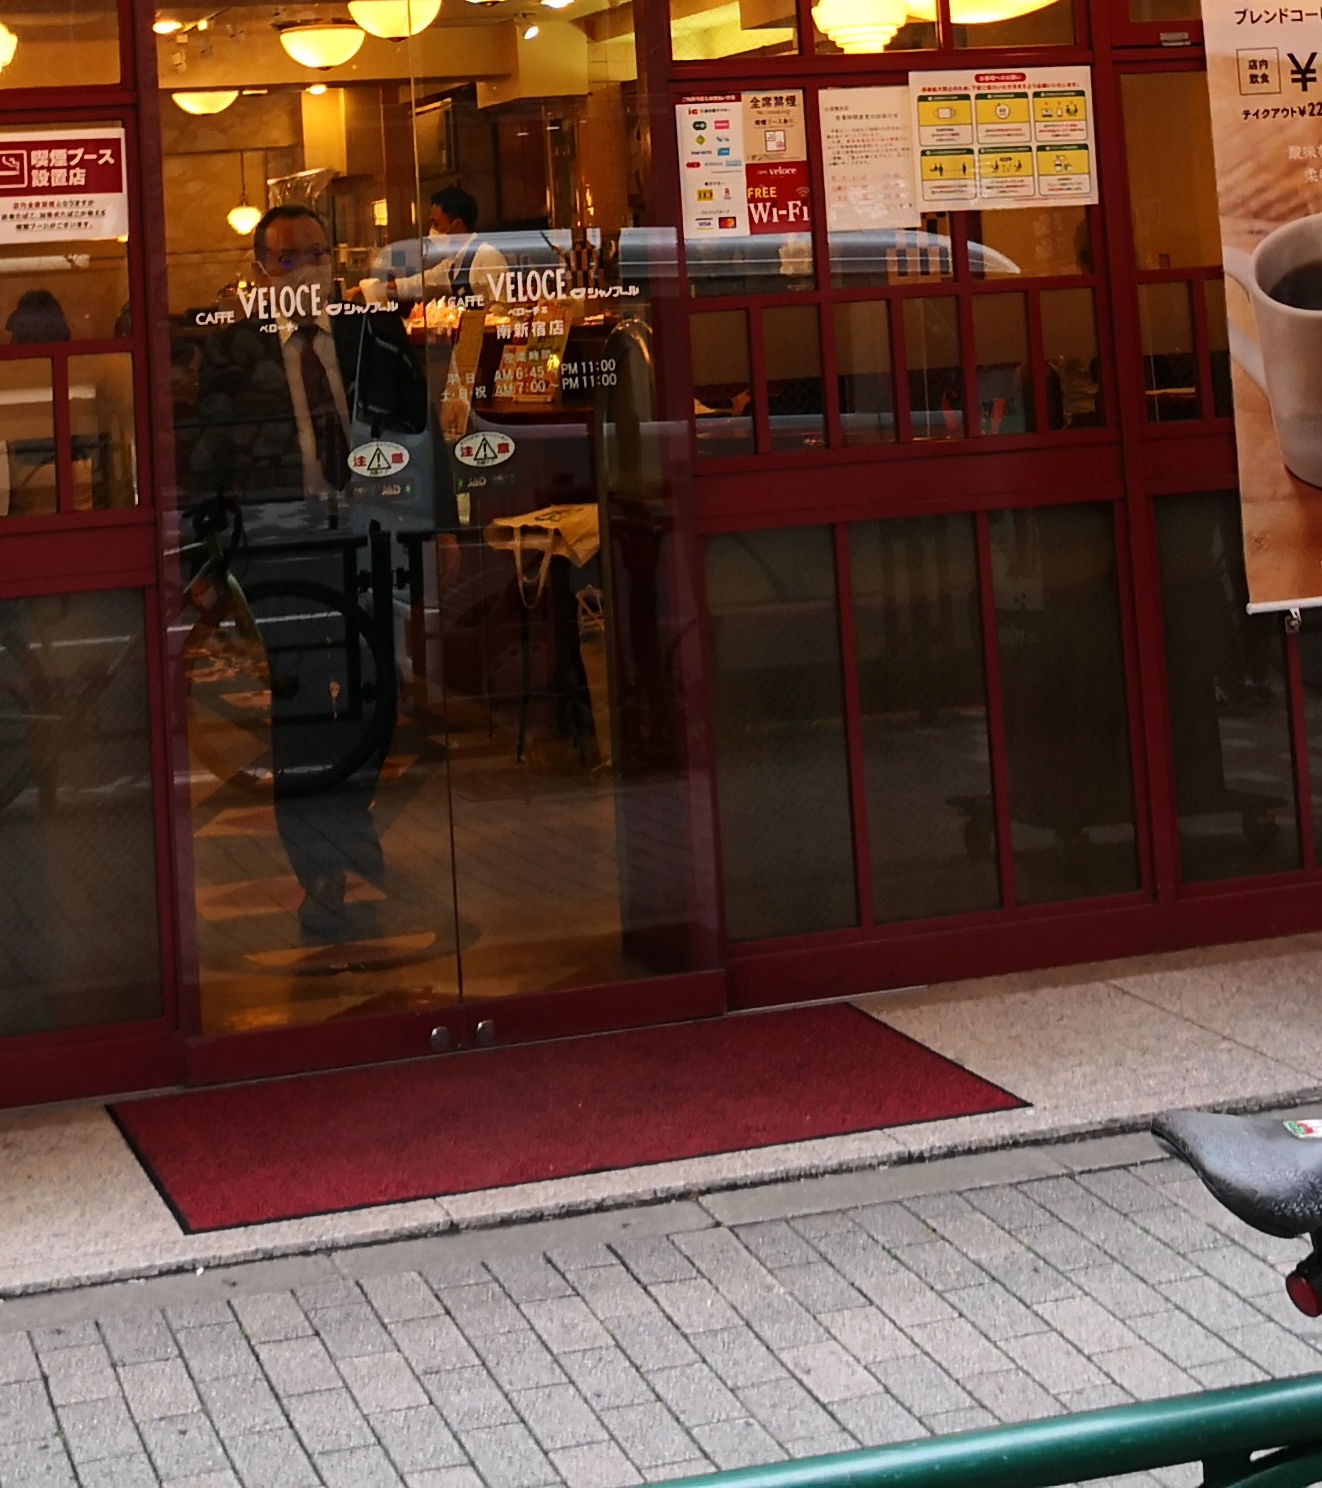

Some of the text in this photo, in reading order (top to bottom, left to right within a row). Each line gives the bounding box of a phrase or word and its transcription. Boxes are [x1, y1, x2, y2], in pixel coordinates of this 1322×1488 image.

[30, 147, 115, 168] 喫煙ブース
[31, 167, 86, 188] 設置店
[747, 186, 777, 199] FREE
[748, 200, 810, 224] Wi-Fi
[447, 294, 485, 308] CAFFE
[486, 268, 567, 303] VELOCE
[196, 310, 235, 326] CAFFE
[237, 283, 322, 320] VELOCE
[496, 319, 565, 340] 南新宿店
[494, 368, 512, 382] AM
[561, 362, 578, 376] PM
[581, 358, 616, 373] 11:00
[495, 382, 514, 396] AM
[518, 378, 546, 394] 7:00
[562, 376, 579, 391] PM
[582, 373, 617, 388] 11:00
